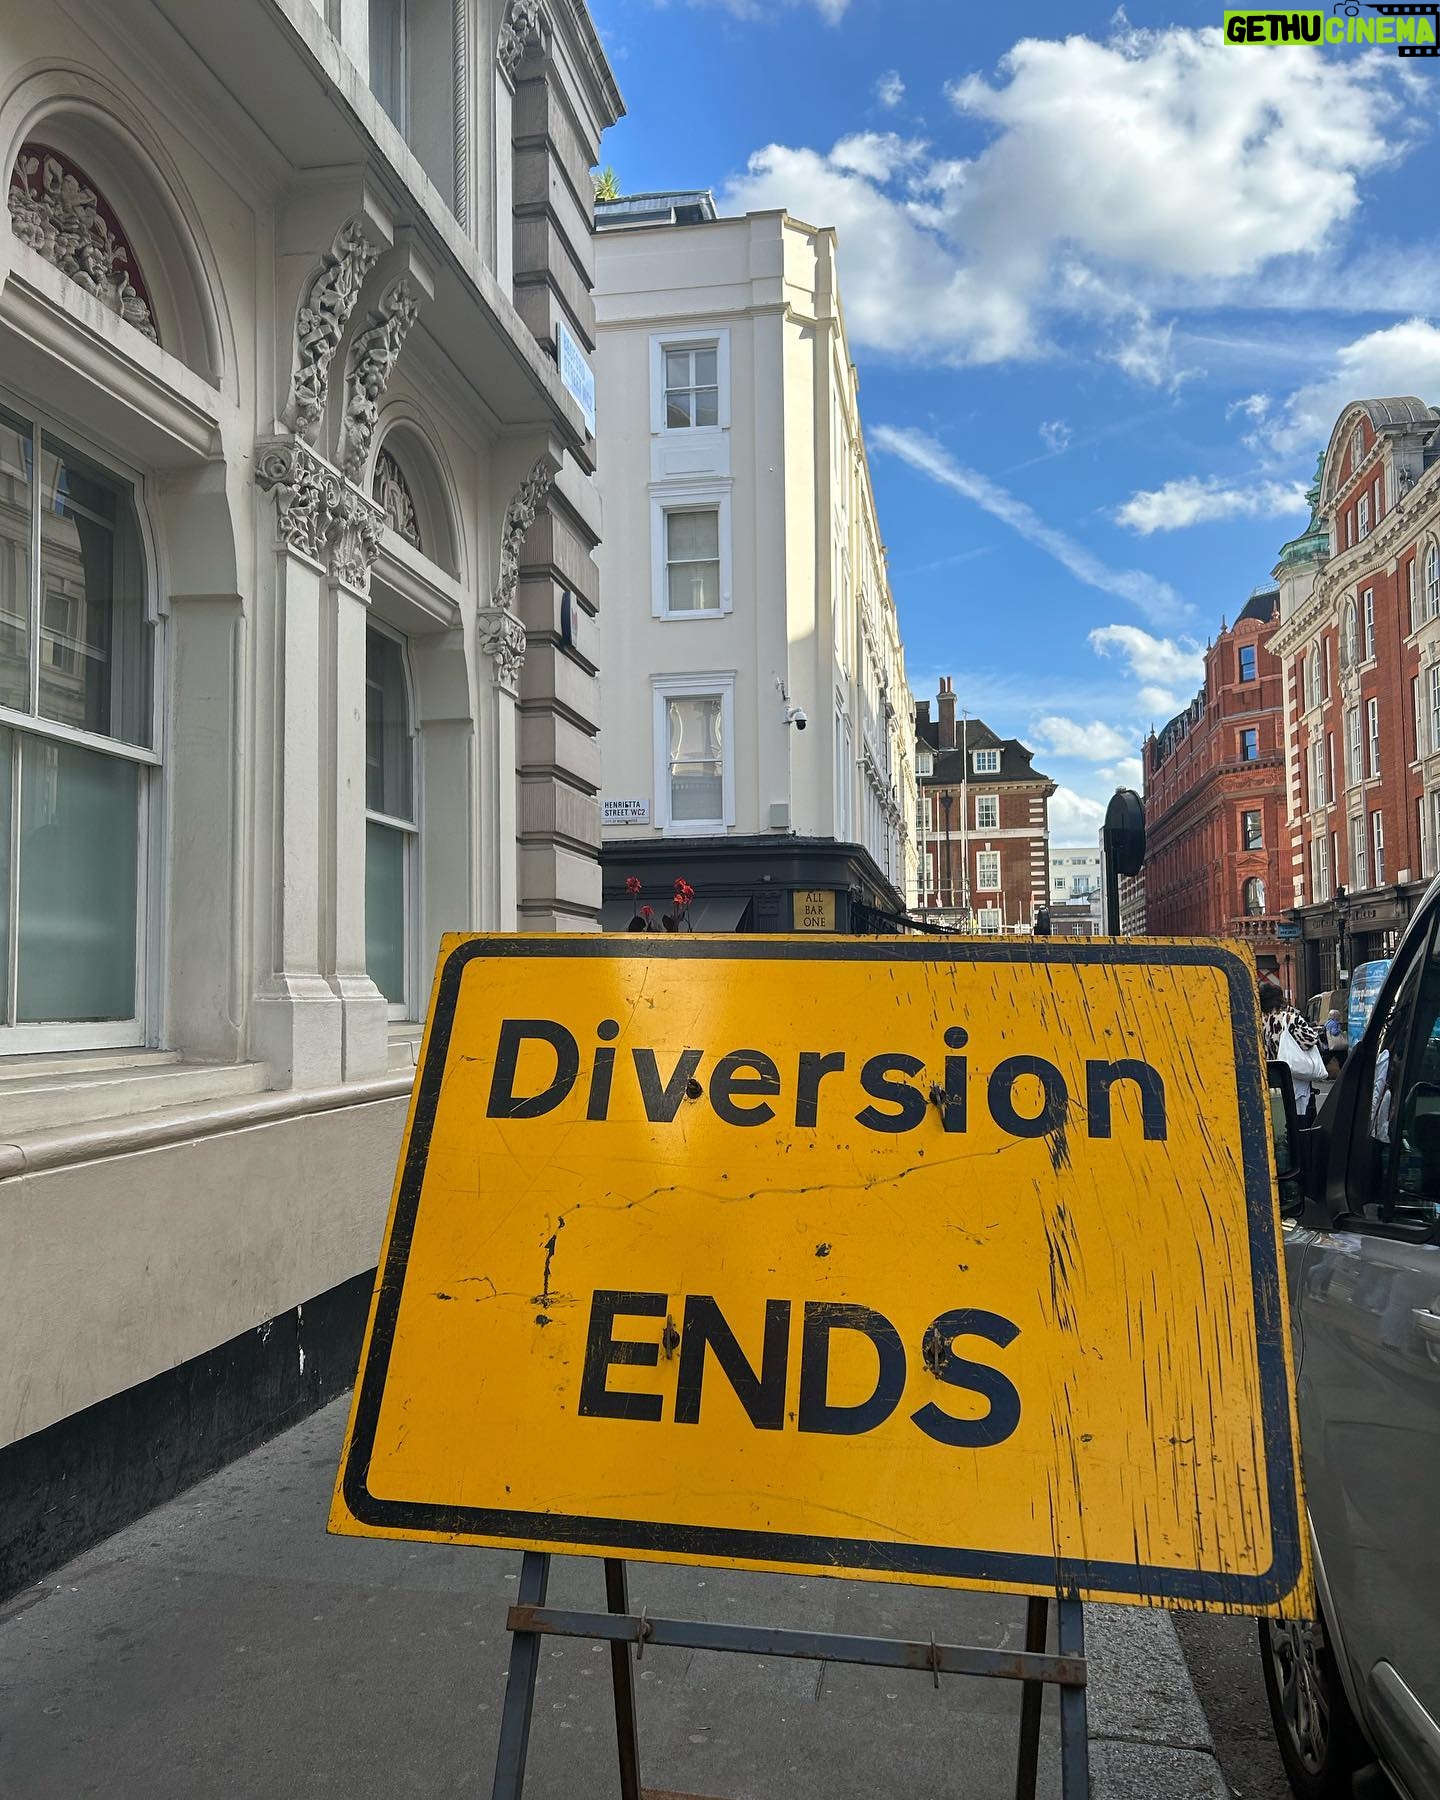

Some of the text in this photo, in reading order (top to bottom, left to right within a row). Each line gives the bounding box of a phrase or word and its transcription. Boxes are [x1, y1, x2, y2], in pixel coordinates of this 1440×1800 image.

[604, 801, 641, 809] HENRIETTA
[604, 808, 646, 817] STREET WC2
[805, 892, 824, 902] ALL
[805, 905, 824, 915] BAR
[803, 917, 826, 927] ONE
[485, 1018, 1168, 1142] Diversion
[577, 1289, 1022, 1448] ENDS
